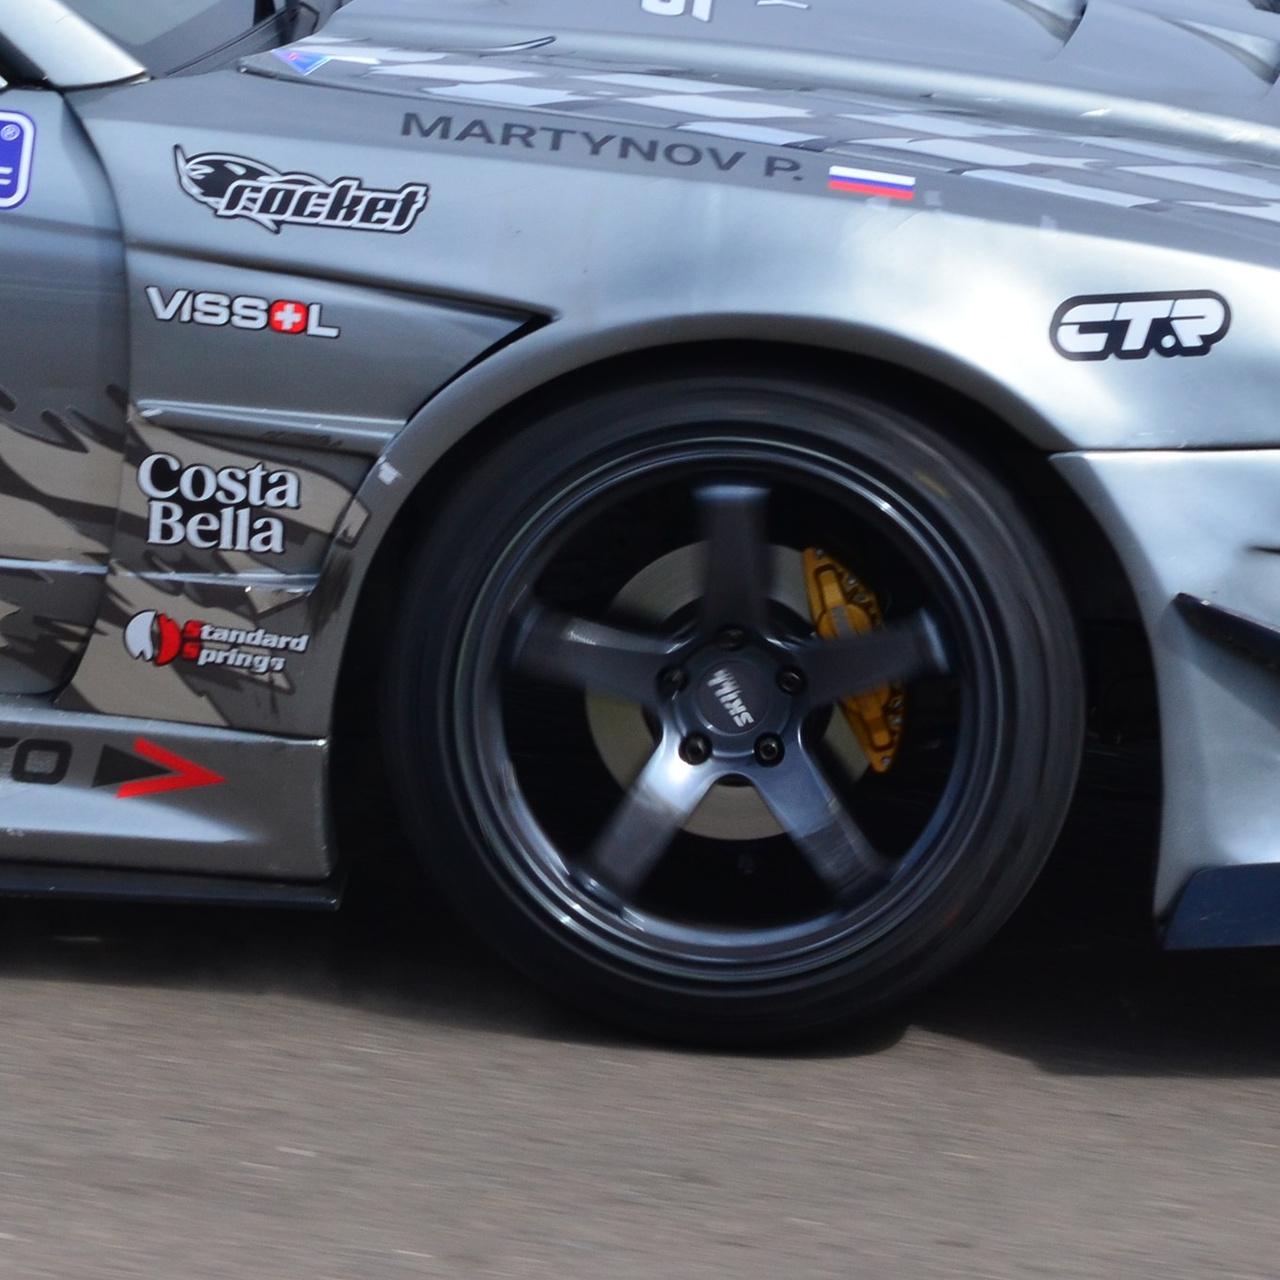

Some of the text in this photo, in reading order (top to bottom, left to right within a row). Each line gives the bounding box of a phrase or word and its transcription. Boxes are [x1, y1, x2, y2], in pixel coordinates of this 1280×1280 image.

[400, 111, 803, 182] MARTYNOV P.
[136, 451, 302, 509] Costa
[146, 499, 286, 554] Bella
[179, 641, 288, 675] Springs
[181, 618, 312, 654] Standard
